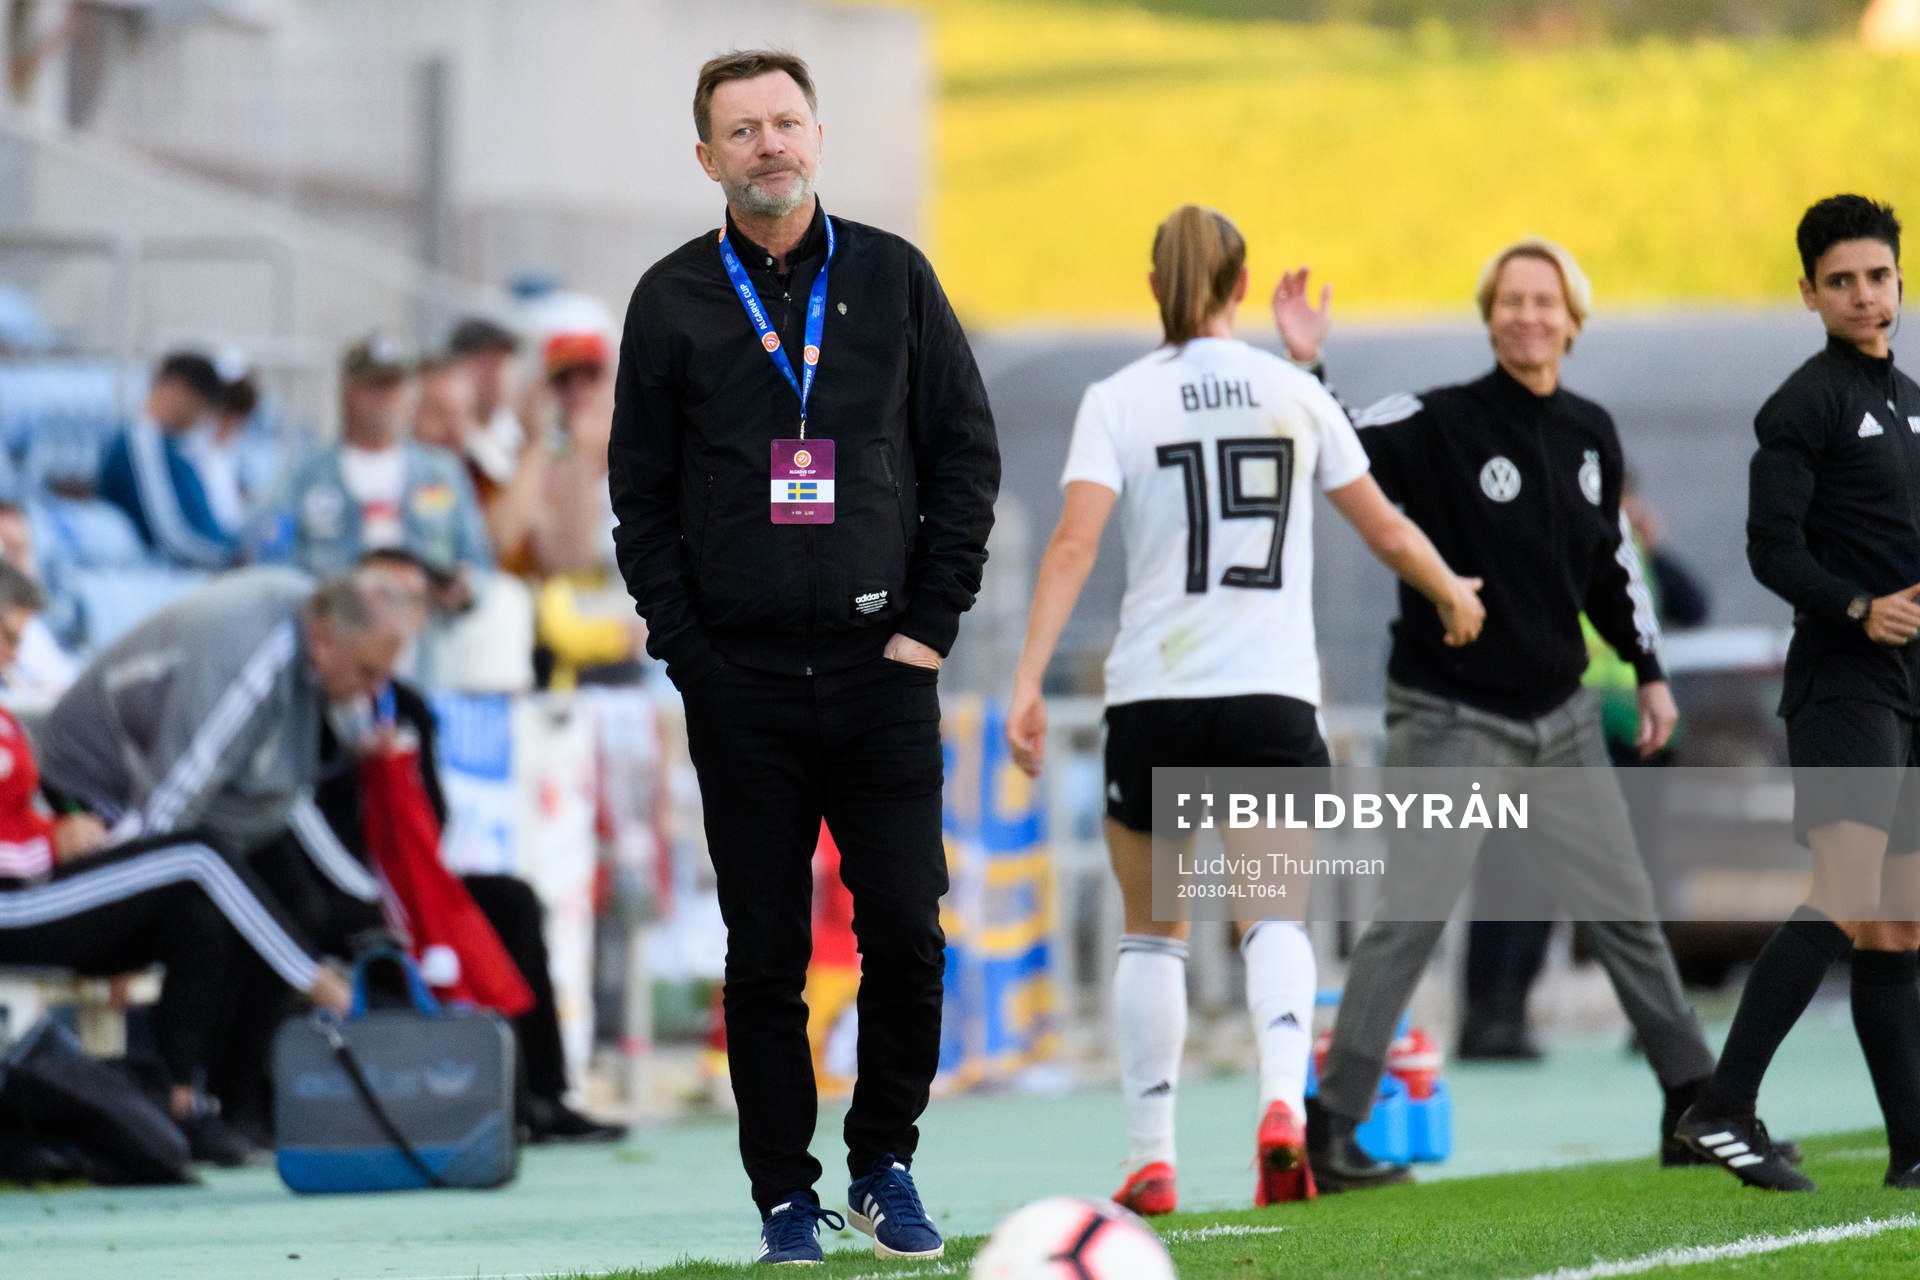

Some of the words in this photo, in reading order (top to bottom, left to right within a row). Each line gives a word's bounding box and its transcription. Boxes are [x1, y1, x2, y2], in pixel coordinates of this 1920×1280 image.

[740, 284, 752, 299] CUP
[747, 298, 768, 330] ALGARVE
[1180, 373, 1260, 412] BÜHL
[1156, 437, 1294, 594] 19
[855, 592, 880, 604] adidas
